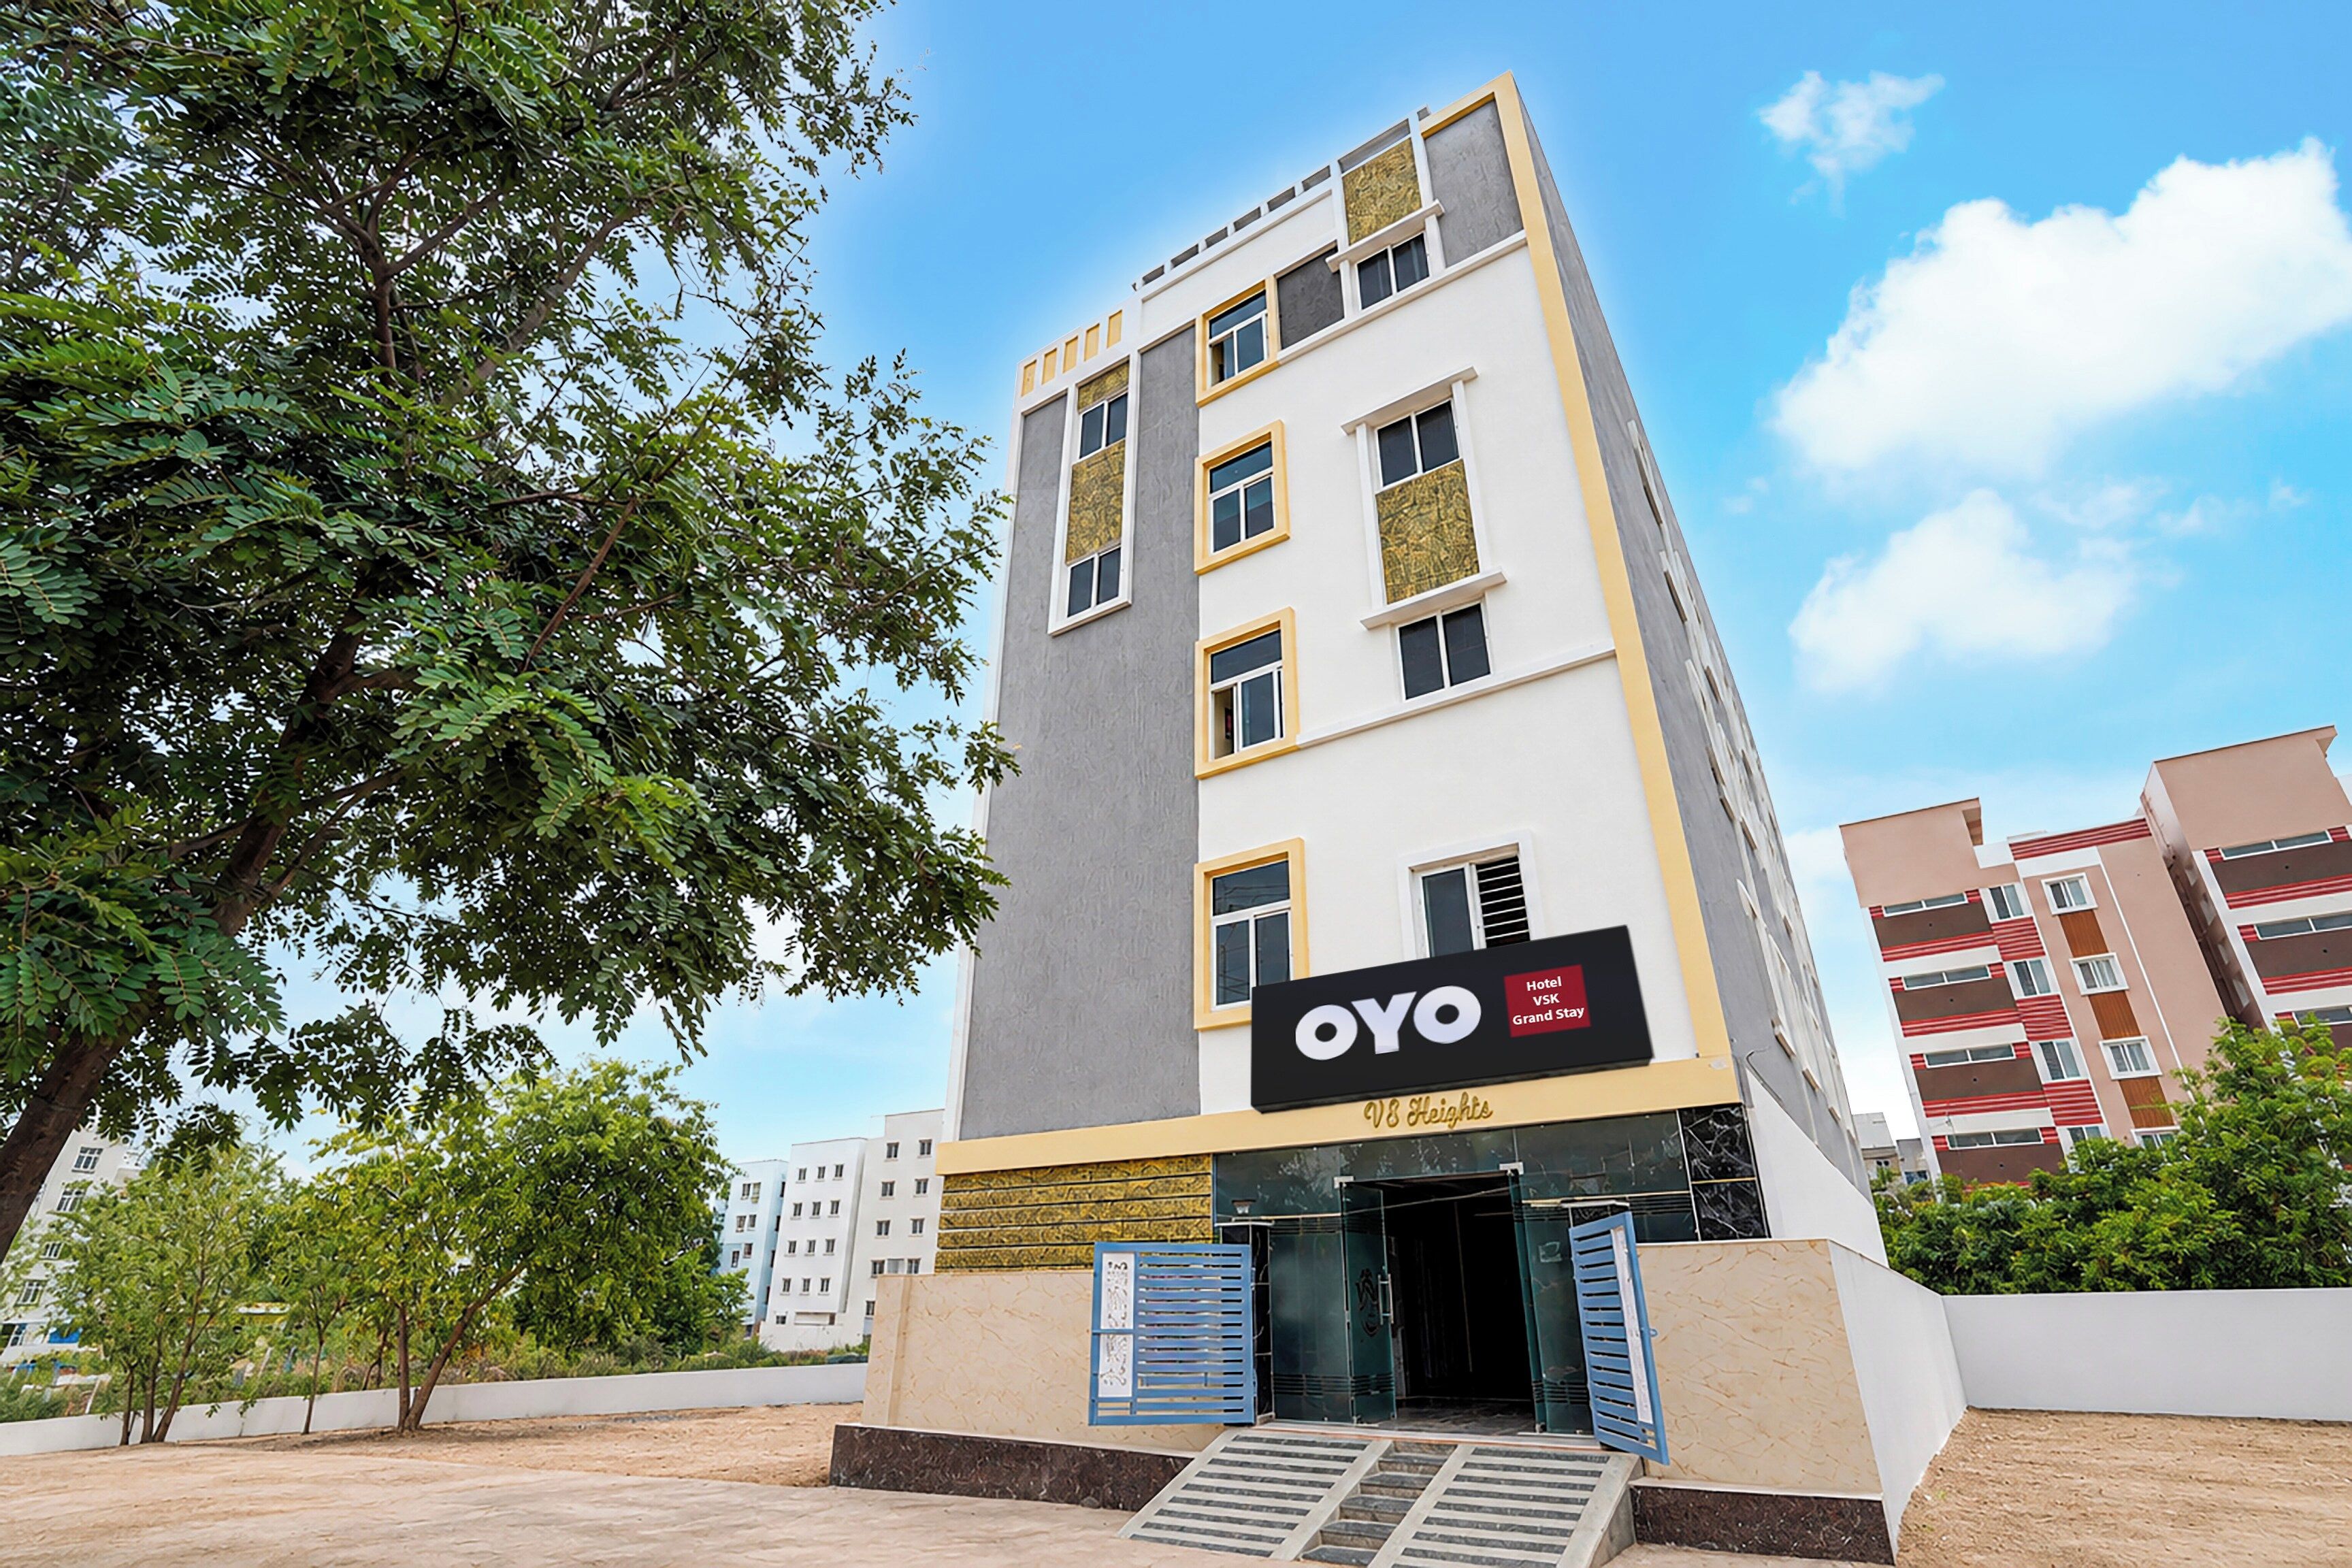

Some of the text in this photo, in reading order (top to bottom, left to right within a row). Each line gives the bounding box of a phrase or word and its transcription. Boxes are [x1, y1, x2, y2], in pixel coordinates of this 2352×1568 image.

[1526, 976, 1562, 992] Hotel
[1533, 994, 1560, 1006] VSK
[1296, 985, 1482, 1060] OYO
[1512, 1007, 1584, 1025] Grand Stay
[1407, 1091, 1494, 1129] Heights
